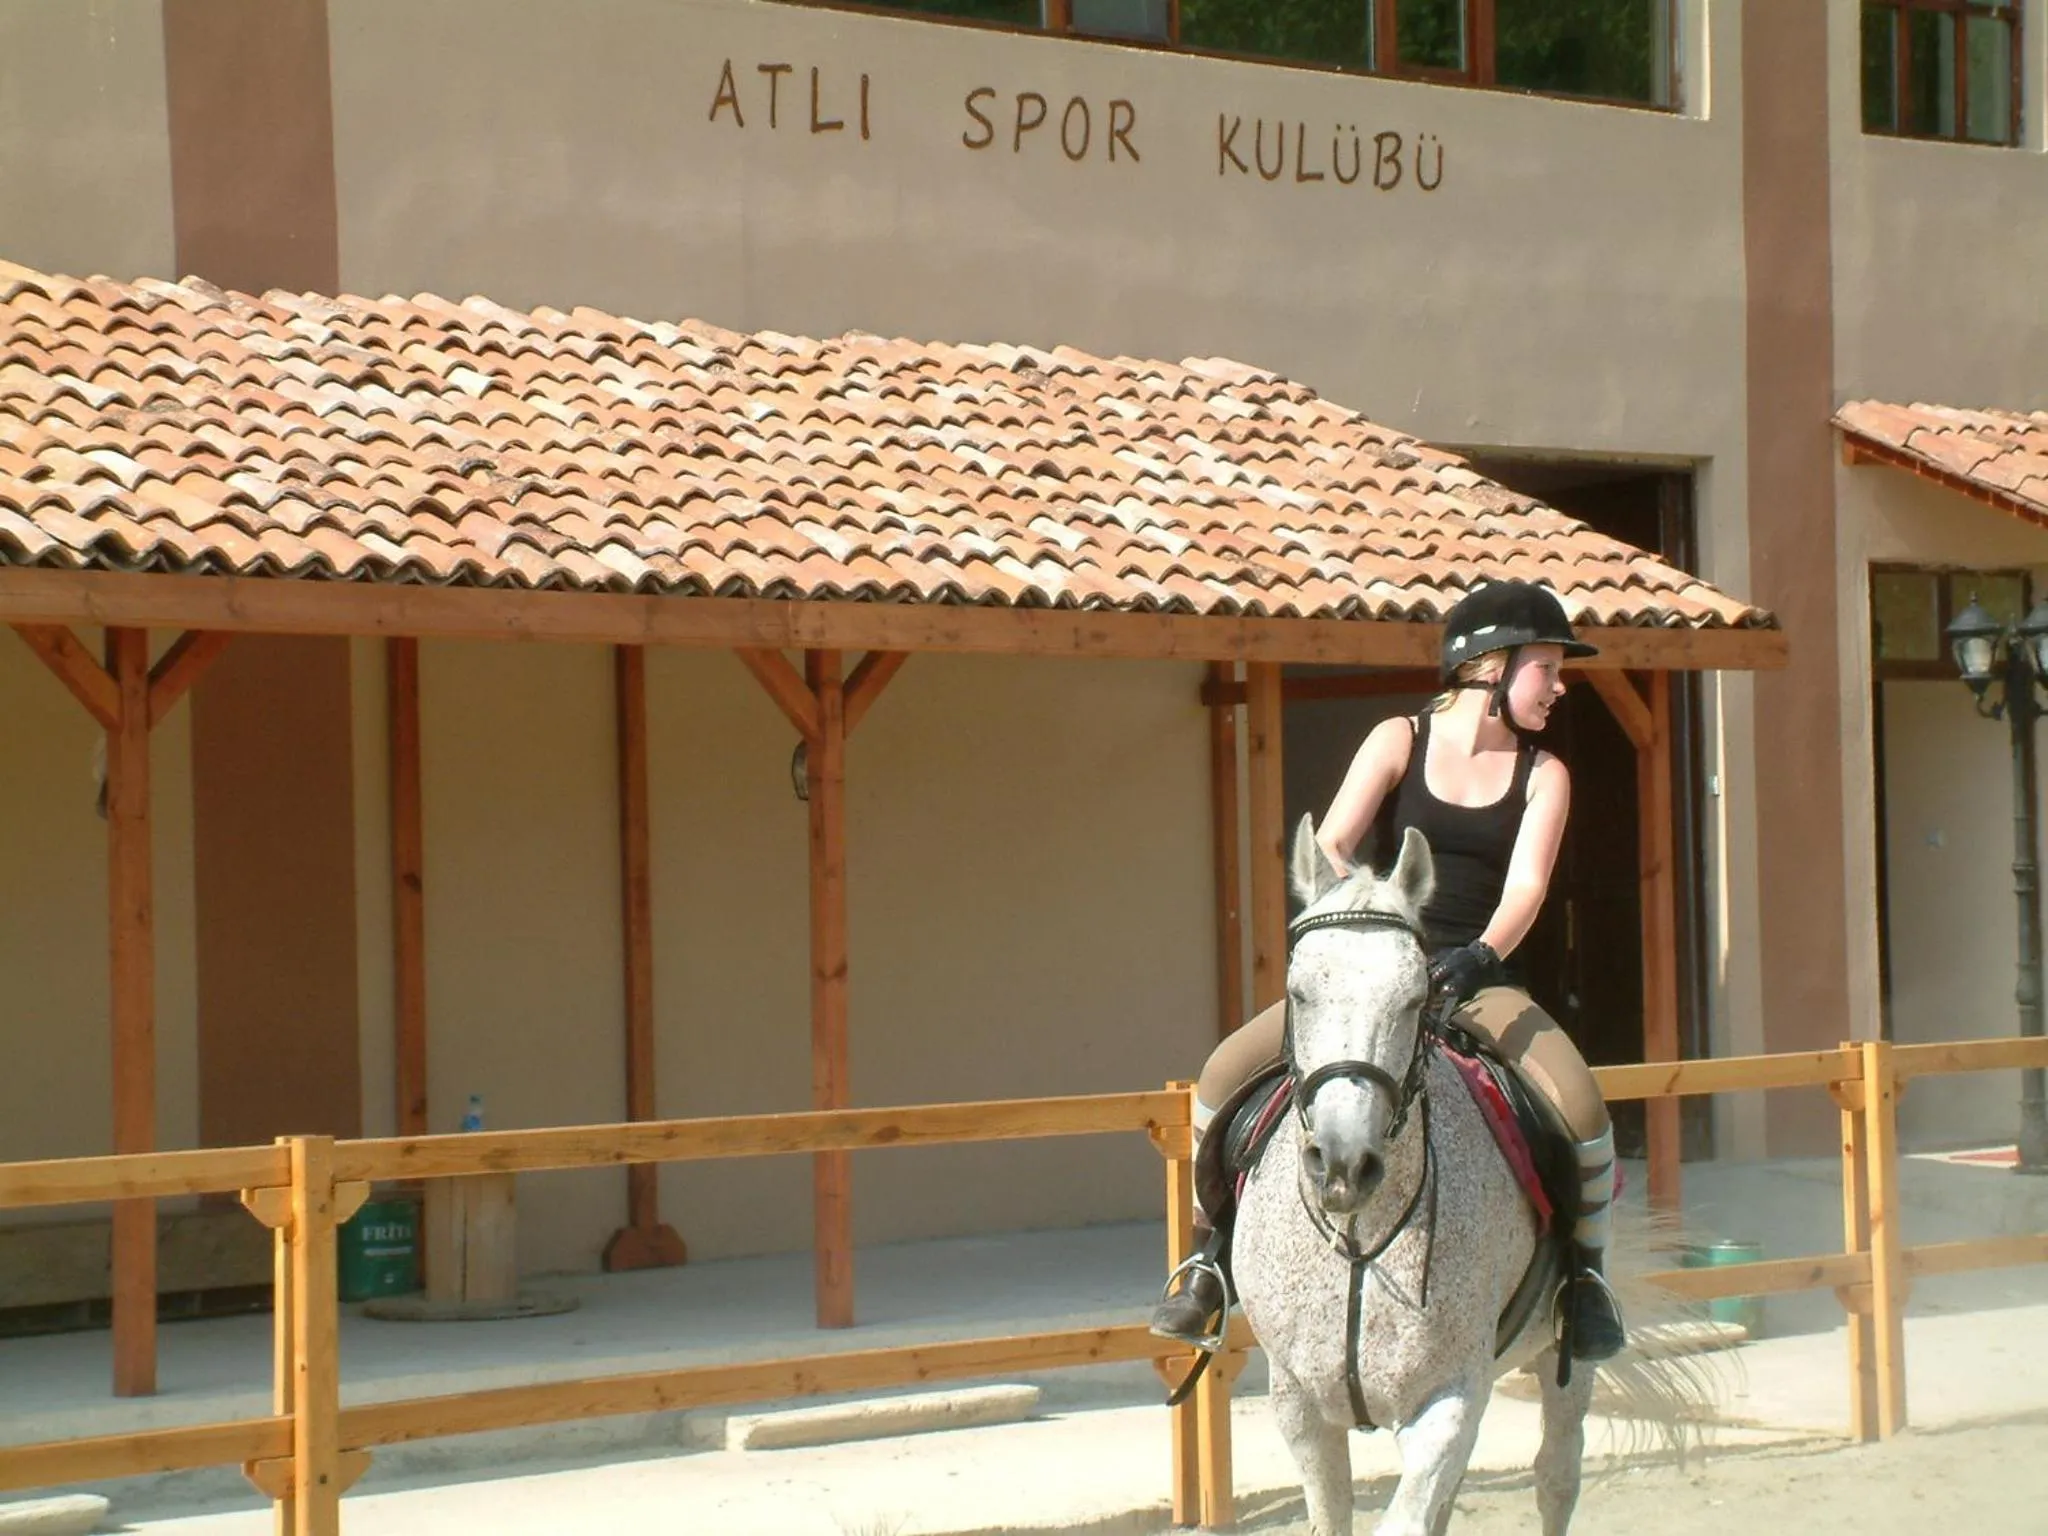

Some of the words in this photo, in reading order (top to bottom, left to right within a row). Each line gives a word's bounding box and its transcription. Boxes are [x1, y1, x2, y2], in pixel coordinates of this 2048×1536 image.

[708, 58, 871, 142] ATLI
[962, 86, 1141, 163] SPOR
[1218, 112, 1444, 193] KULÜBÜ
